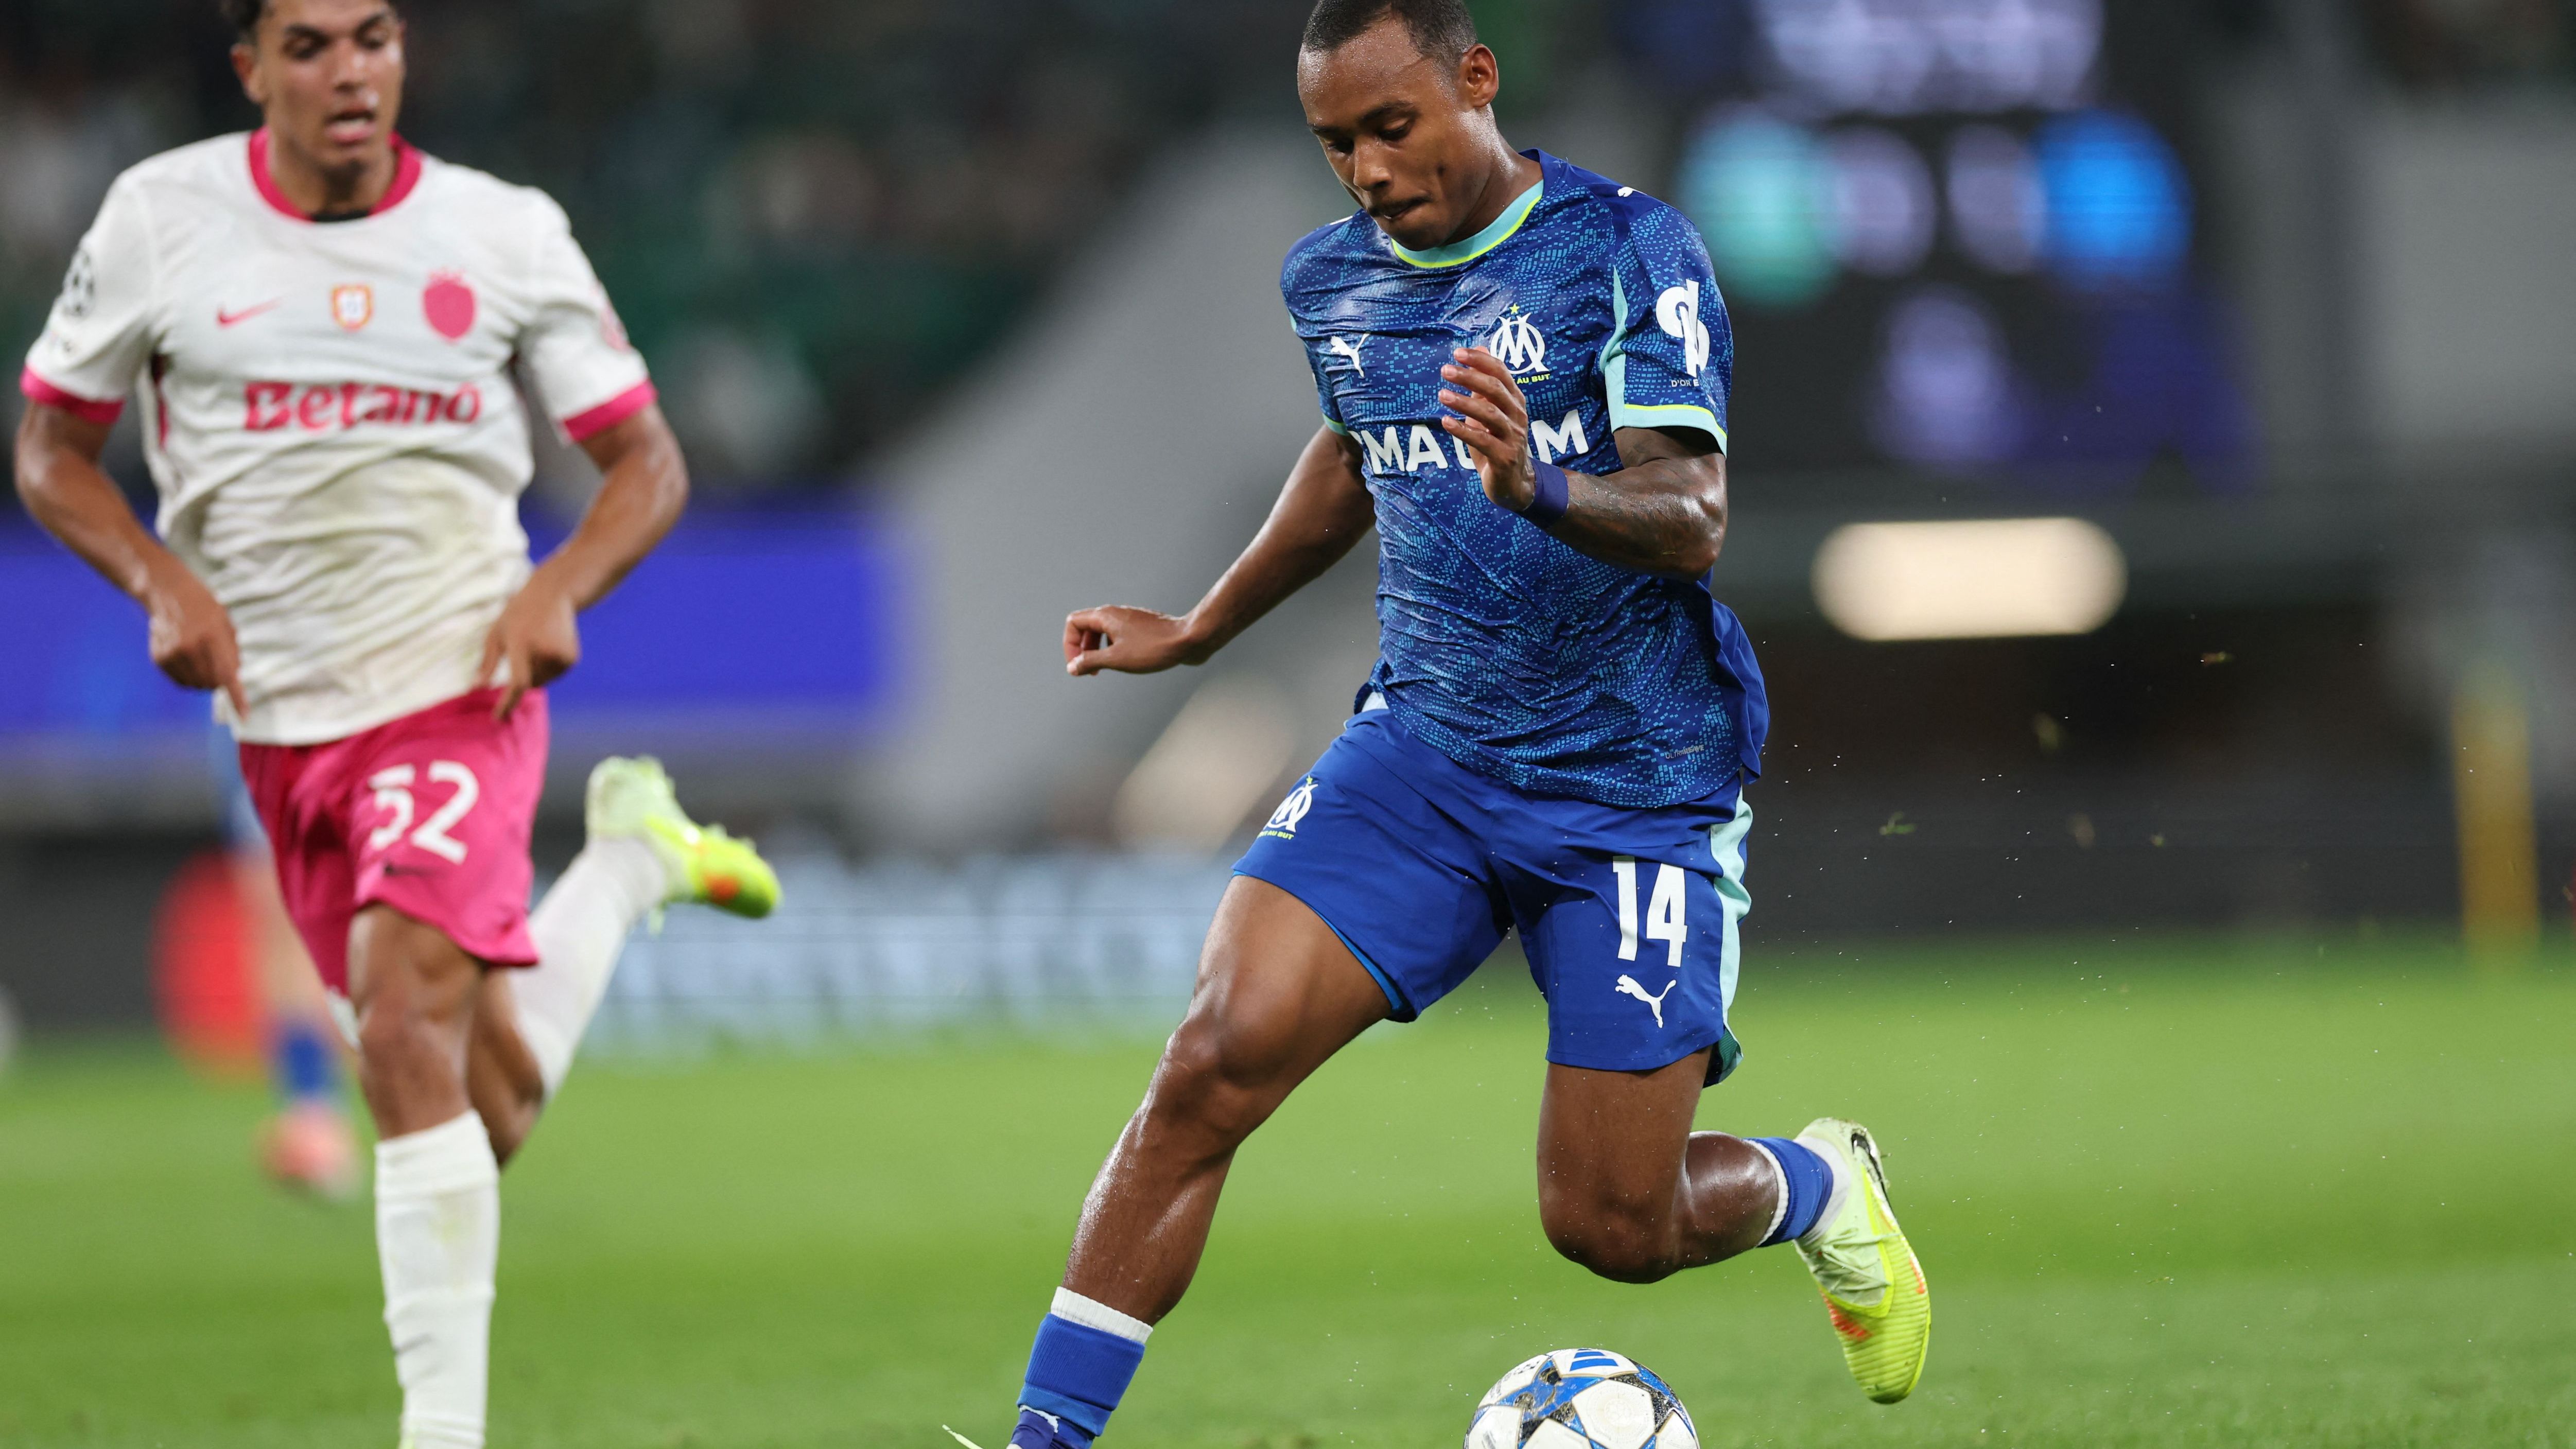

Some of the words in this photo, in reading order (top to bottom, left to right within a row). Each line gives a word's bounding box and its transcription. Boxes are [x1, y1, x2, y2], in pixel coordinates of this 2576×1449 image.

[1531, 373, 1551, 382] BUT
[244, 380, 482, 431] Betano
[1347, 424, 1449, 475] MA
[1665, 744, 1705, 759] ULTRAWEAVE
[369, 761, 479, 865] 52
[1277, 831, 1295, 840] BUT
[1613, 856, 1688, 968] 14
